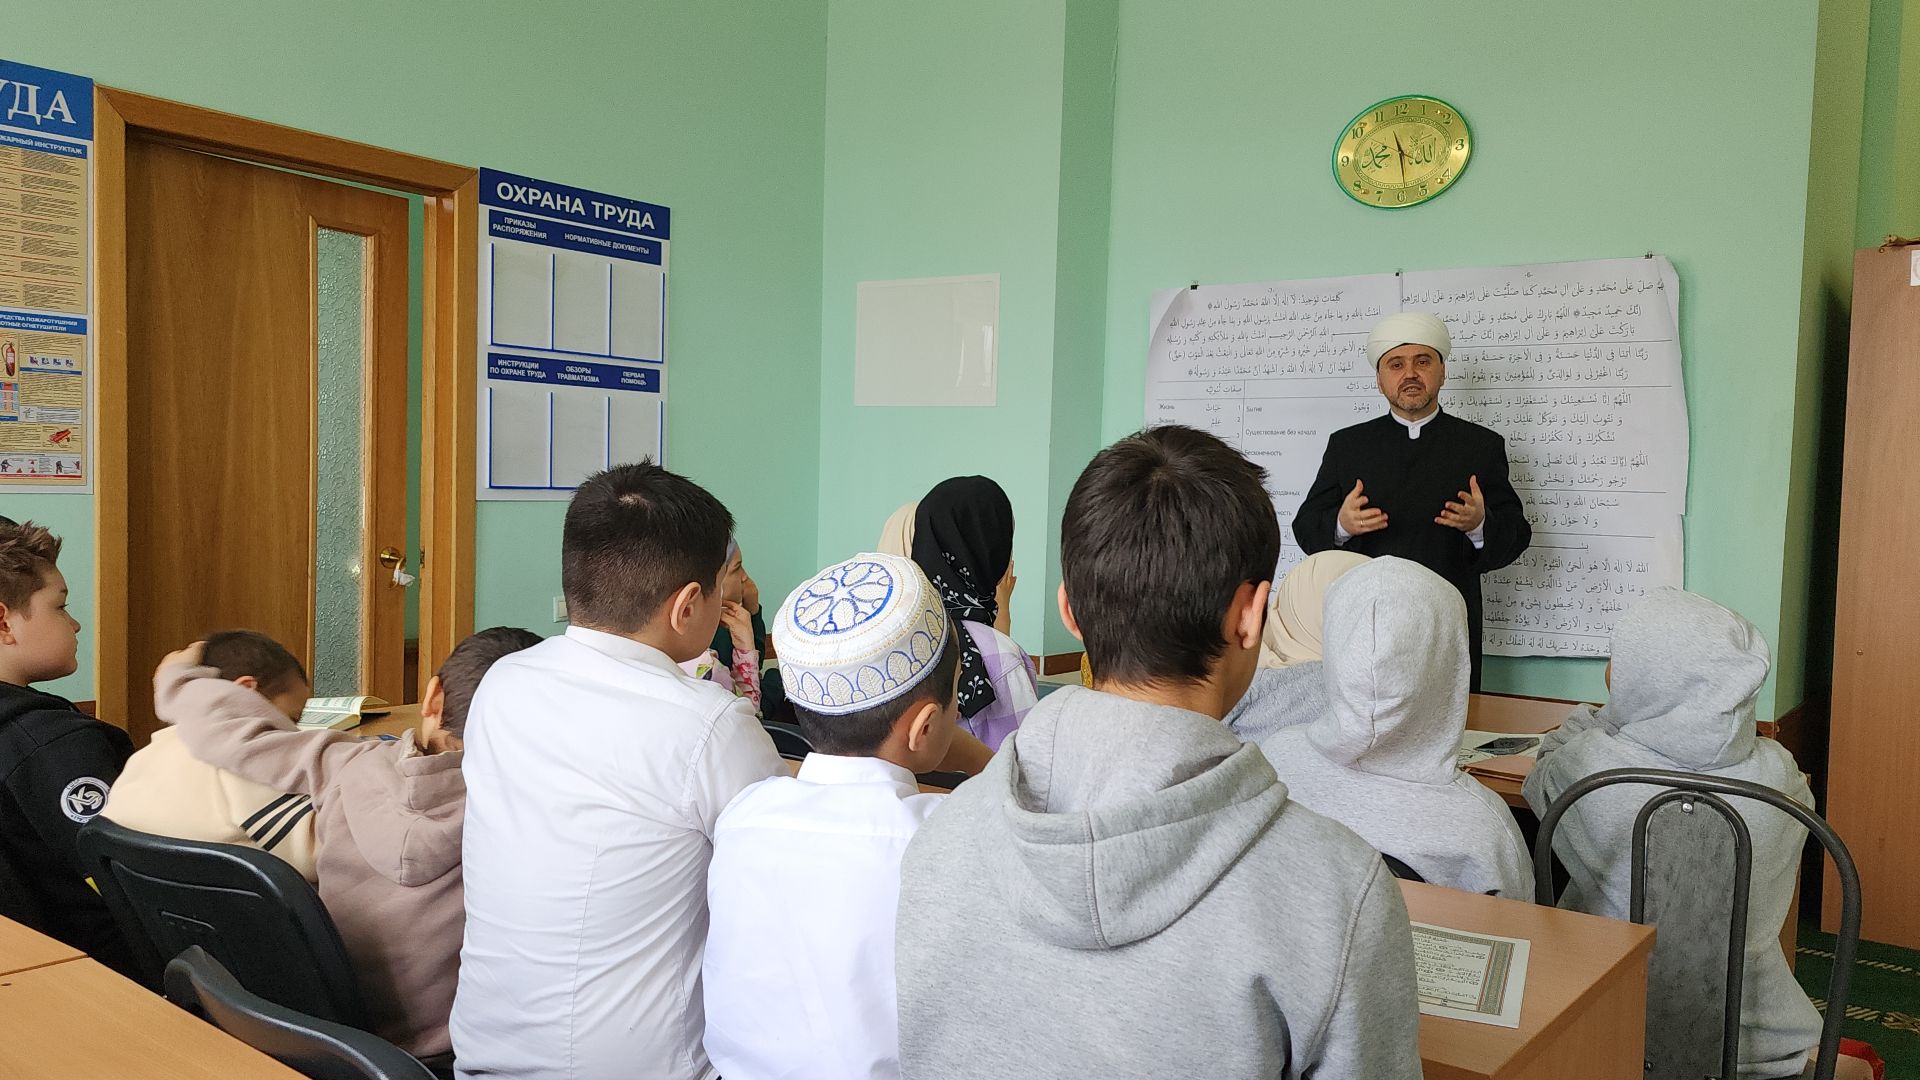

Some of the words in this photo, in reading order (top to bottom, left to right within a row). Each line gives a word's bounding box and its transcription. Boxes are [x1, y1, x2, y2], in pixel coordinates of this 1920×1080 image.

[1394, 103, 1408, 116] 12
[1421, 104, 1426, 115] 1
[1375, 111, 1384, 123] 11
[1442, 113, 1451, 125] 2
[1352, 127, 1364, 139] 10
[34, 140, 82, 154] ИНСТРУКТАЖ
[1455, 138, 1464, 150] 3
[1341, 156, 1349, 167] 9
[1442, 168, 1452, 179] 4
[1353, 180, 1362, 191] 8
[1419, 185, 1428, 196] 5
[1376, 191, 1384, 202] 7
[1397, 190, 1406, 202] 6
[496, 182, 586, 216] ОХРАНА
[591, 201, 655, 230] ТРУДА
[504, 217, 537, 229] ПРИКАЗЫ
[492, 224, 547, 239] РАСПОРЯЖЕНИЯ
[564, 233, 611, 248] НОРМАТИВНЫЕ
[612, 241, 650, 255] ДОКУМЕНТЫ
[498, 359, 540, 370] ИНСТРУКЦИИ
[566, 366, 592, 374] ОБЗОРЫ
[501, 368, 526, 377] ОХРАНЕ
[527, 370, 547, 379] ТРУДА
[557, 372, 600, 383] ТРАВМАТИЗМА
[623, 371, 645, 379] ПЕРВАЯ
[621, 378, 647, 386] ПОМОЩЬ
[1245, 429, 1286, 437] Существование
